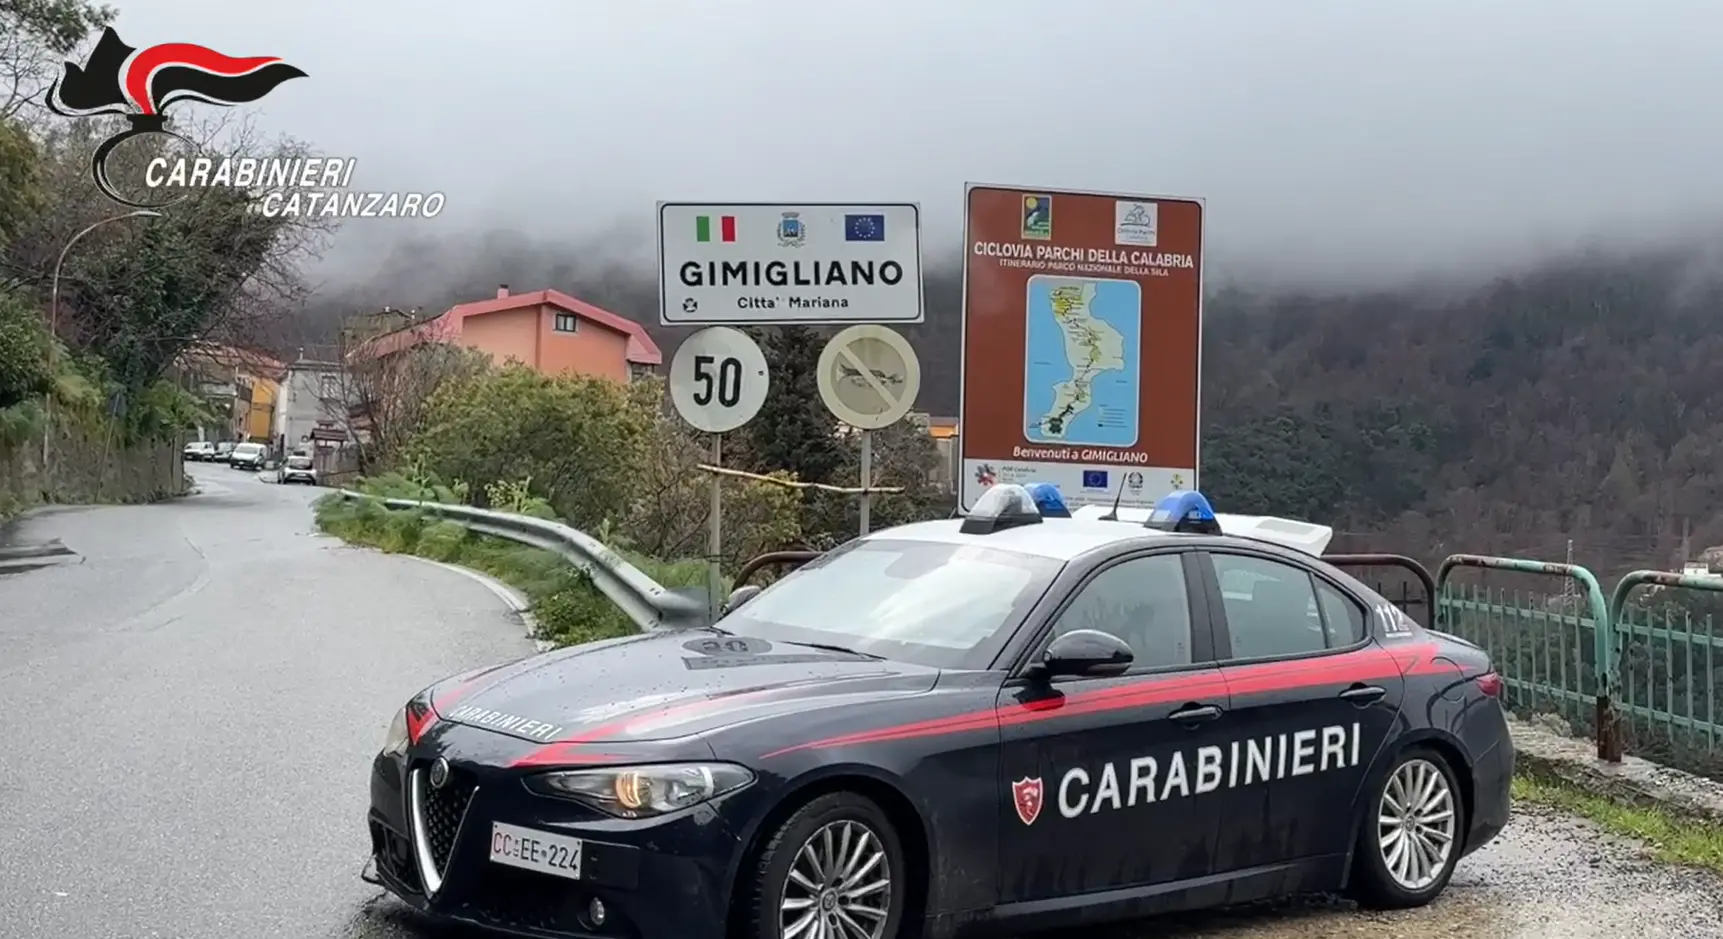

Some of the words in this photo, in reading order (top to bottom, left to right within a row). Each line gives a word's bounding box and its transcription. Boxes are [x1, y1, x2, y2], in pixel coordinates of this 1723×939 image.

[974, 241, 1034, 259] CICLOVIA
[1036, 245, 1085, 262] PARCHI
[1088, 248, 1129, 264] DELLA
[1131, 251, 1194, 269] CALABRIA
[999, 258, 1046, 270] ITINERARIO
[1047, 260, 1076, 272] PARCO
[1077, 262, 1122, 274] NAZIONALE
[1124, 265, 1149, 275] DELLA
[1151, 266, 1169, 277] SILA
[679, 260, 903, 287] GIMIGLIANO
[737, 296, 780, 309] Citta'
[788, 296, 849, 309] Mariana
[693, 355, 742, 408] 50
[1012, 445, 1070, 460] Benvenuti
[1071, 449, 1079, 460] a
[1081, 448, 1149, 464] GIMIGLIANO
[1057, 722, 1361, 819] CARABINIERI
